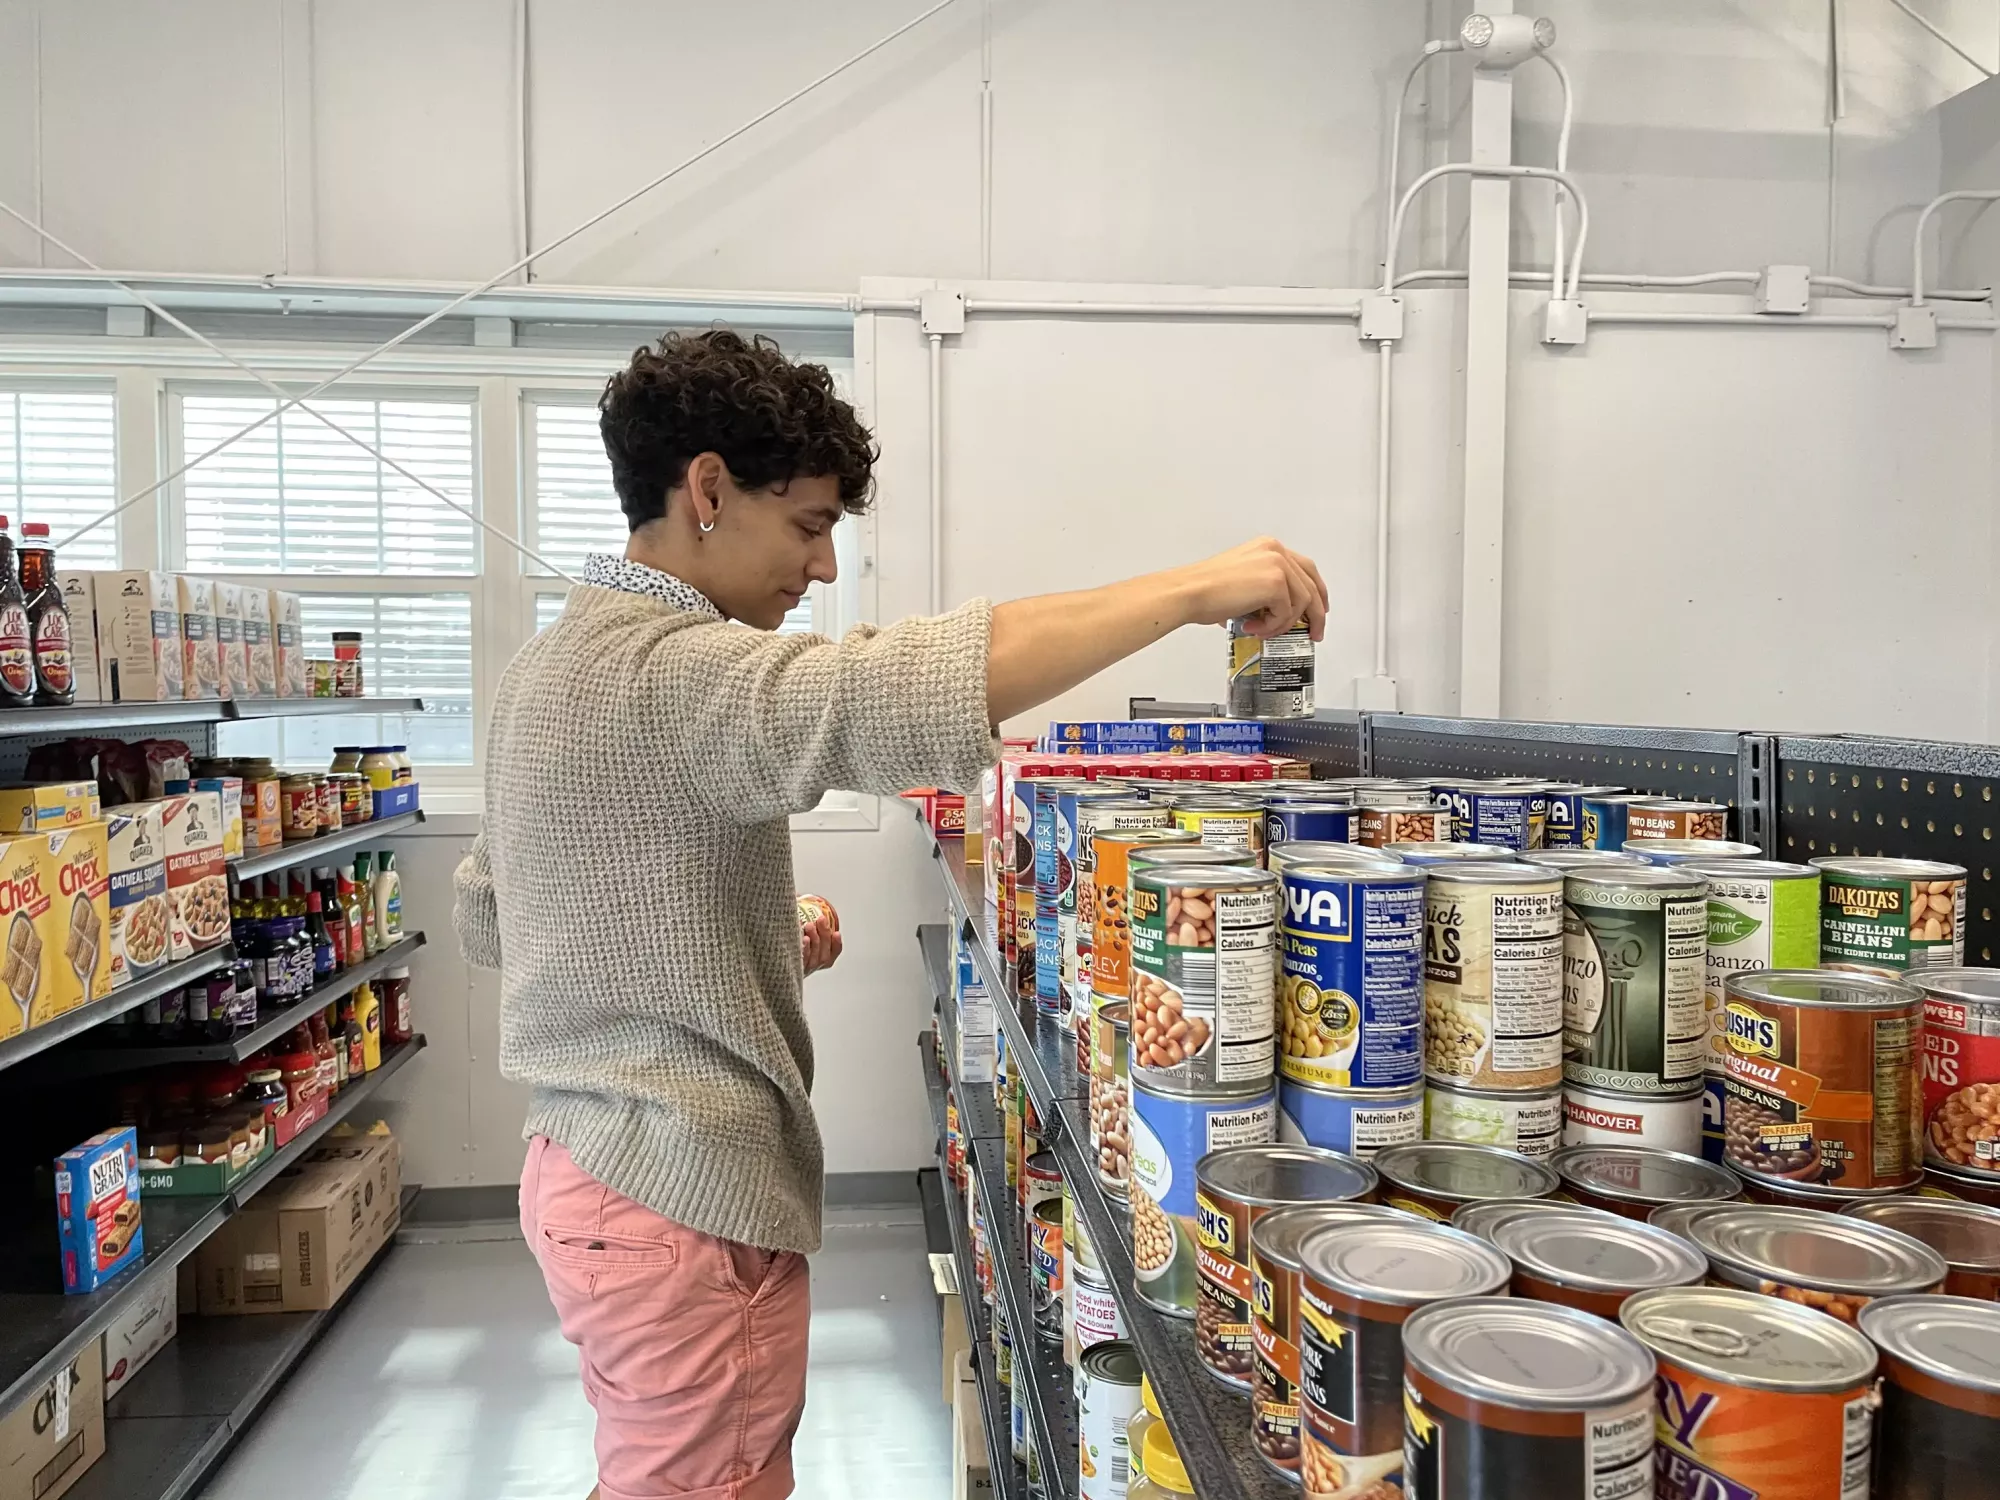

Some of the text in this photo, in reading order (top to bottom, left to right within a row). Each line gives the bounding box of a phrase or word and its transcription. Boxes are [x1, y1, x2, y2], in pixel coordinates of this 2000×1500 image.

[1114, 817, 1151, 825] Nutrition
[1647, 819, 1676, 830] BEANS
[73, 848, 94, 866] Wheat
[169, 854, 199, 872] OATMEAL
[12, 862, 36, 882] Wheat
[59, 857, 101, 897] Chex
[111, 871, 143, 890] OATMEAL
[0, 872, 42, 916] Chex
[1221, 896, 1260, 908] Nutrition
[1494, 897, 1548, 907] Nutrition
[1829, 885, 1899, 909] DAKOTA'S
[1494, 905, 1547, 917] Datos de
[1667, 906, 1704, 916] Nutrition
[1845, 907, 1876, 917] PRIDE
[1823, 919, 1906, 937] CANNELLINI
[1221, 938, 1254, 949] Calories
[1292, 938, 1318, 957] Peas
[1831, 930, 1894, 948] BEANS
[1494, 948, 1536, 958] Calories
[1668, 945, 1701, 956] Calories
[1843, 947, 1875, 959] KIDNEY
[1876, 951, 1906, 961] BEANS
[1924, 1003, 1964, 1022] weis
[1726, 1010, 1774, 1049] USH'S
[1726, 1053, 1782, 1083] riginal
[1740, 1086, 1781, 1110] BEANS
[1211, 1111, 1269, 1128] Nutrition Facts
[1356, 1109, 1416, 1124] Nutrition Facts
[1518, 1109, 1552, 1120] Nutrition
[1776, 1125, 1790, 1135] FAT
[1791, 1124, 1813, 1134] FREE
[1516, 1142, 1549, 1154] Calories
[1820, 1140, 1844, 1149] NET WT
[92, 1152, 123, 1182] NUTRI
[93, 1167, 125, 1197] GRAIN
[1197, 1206, 1230, 1244] SH'S
[1093, 1298, 1116, 1309] white
[1203, 1280, 1236, 1309] BEANS
[1076, 1299, 1116, 1321] POTATOES
[1087, 1319, 1114, 1330] SODIUM
[1302, 1338, 1324, 1372] ORK
[1592, 1413, 1647, 1440] Nutrition
[1593, 1475, 1646, 1500] Calories
